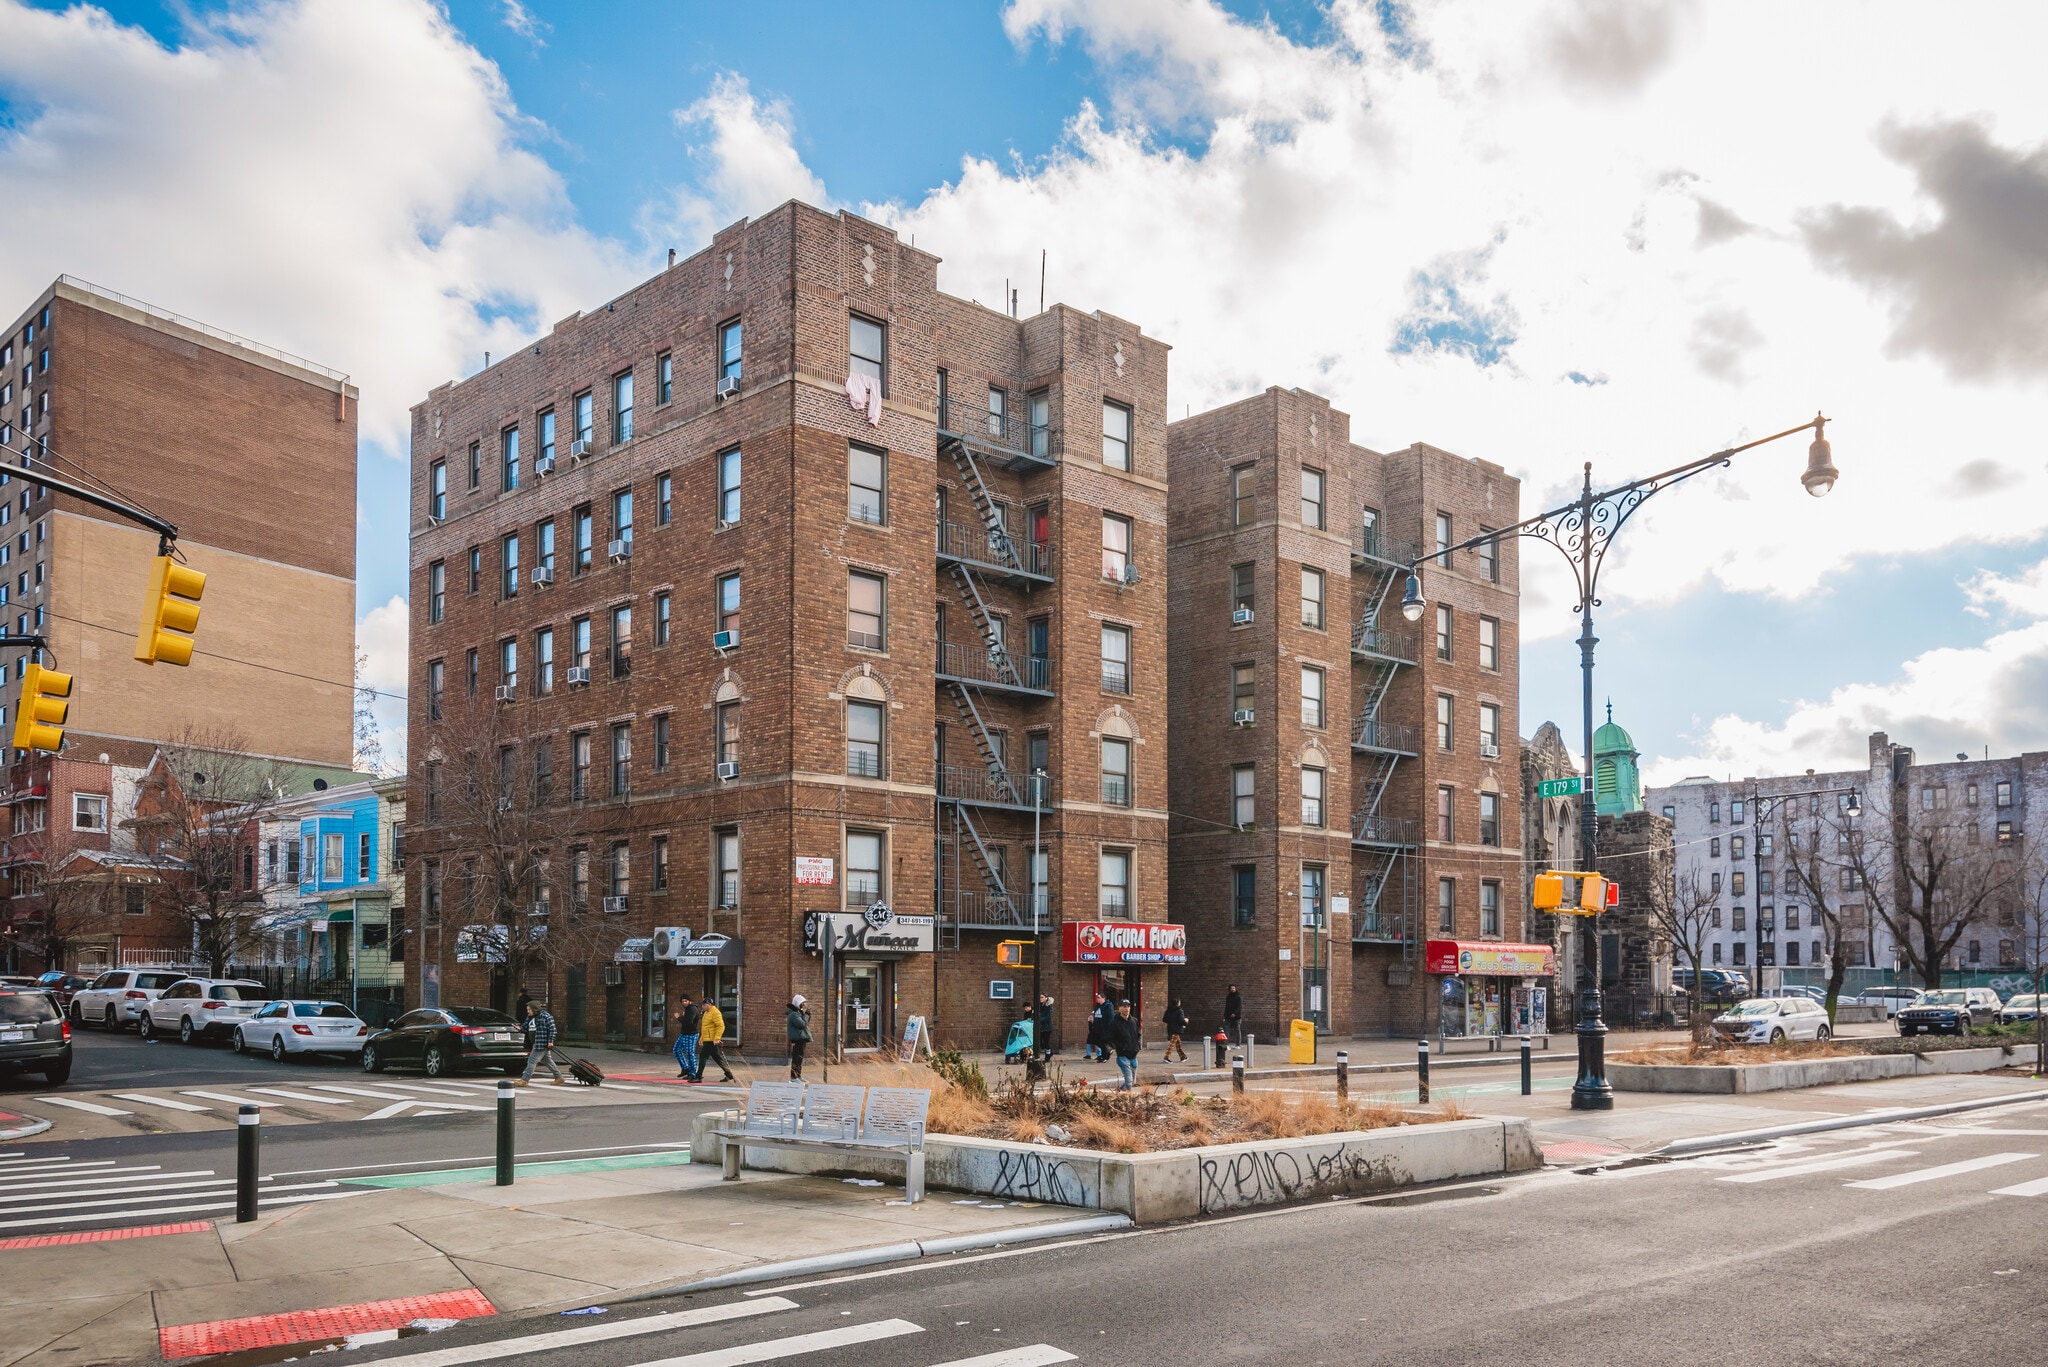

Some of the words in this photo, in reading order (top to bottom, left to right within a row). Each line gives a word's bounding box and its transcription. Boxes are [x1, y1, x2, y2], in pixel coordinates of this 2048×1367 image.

[1543, 783, 1549, 796] E
[1553, 781, 1568, 795] 179
[802, 870, 813, 878] FOR
[813, 870, 829, 879] RENT
[1126, 952, 1147, 960] BARBER
[1147, 953, 1162, 961] SHOP
[1475, 961, 1500, 970] FOOD
[1501, 961, 1542, 971] GROCERY
